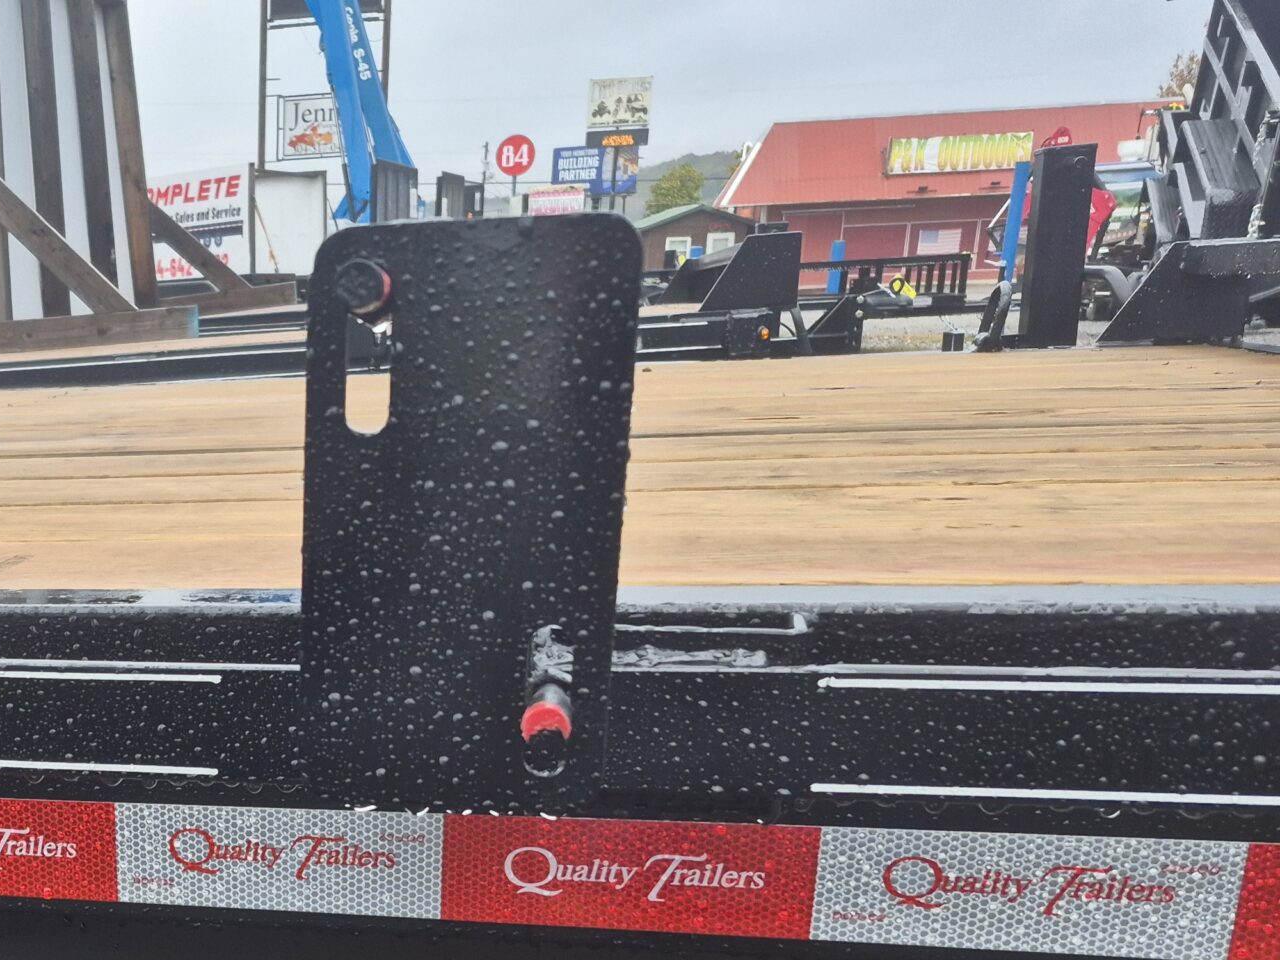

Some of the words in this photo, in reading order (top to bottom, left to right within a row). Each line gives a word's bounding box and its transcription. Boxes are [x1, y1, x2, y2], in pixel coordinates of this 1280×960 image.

[501, 144, 529, 167] 84
[558, 156, 600, 171] BUILDING
[558, 168, 597, 182] PARTNER
[147, 174, 241, 207] OMPLETE
[175, 211, 195, 223] Sales
[196, 207, 210, 221] and
[211, 204, 242, 220] Service
[168, 827, 286, 875] Quality
[290, 833, 396, 880] Trailers
[504, 846, 638, 897] Quality
[643, 853, 766, 902] Trailers
[882, 855, 1030, 910] Quality
[1041, 865, 1176, 917] Trailers
